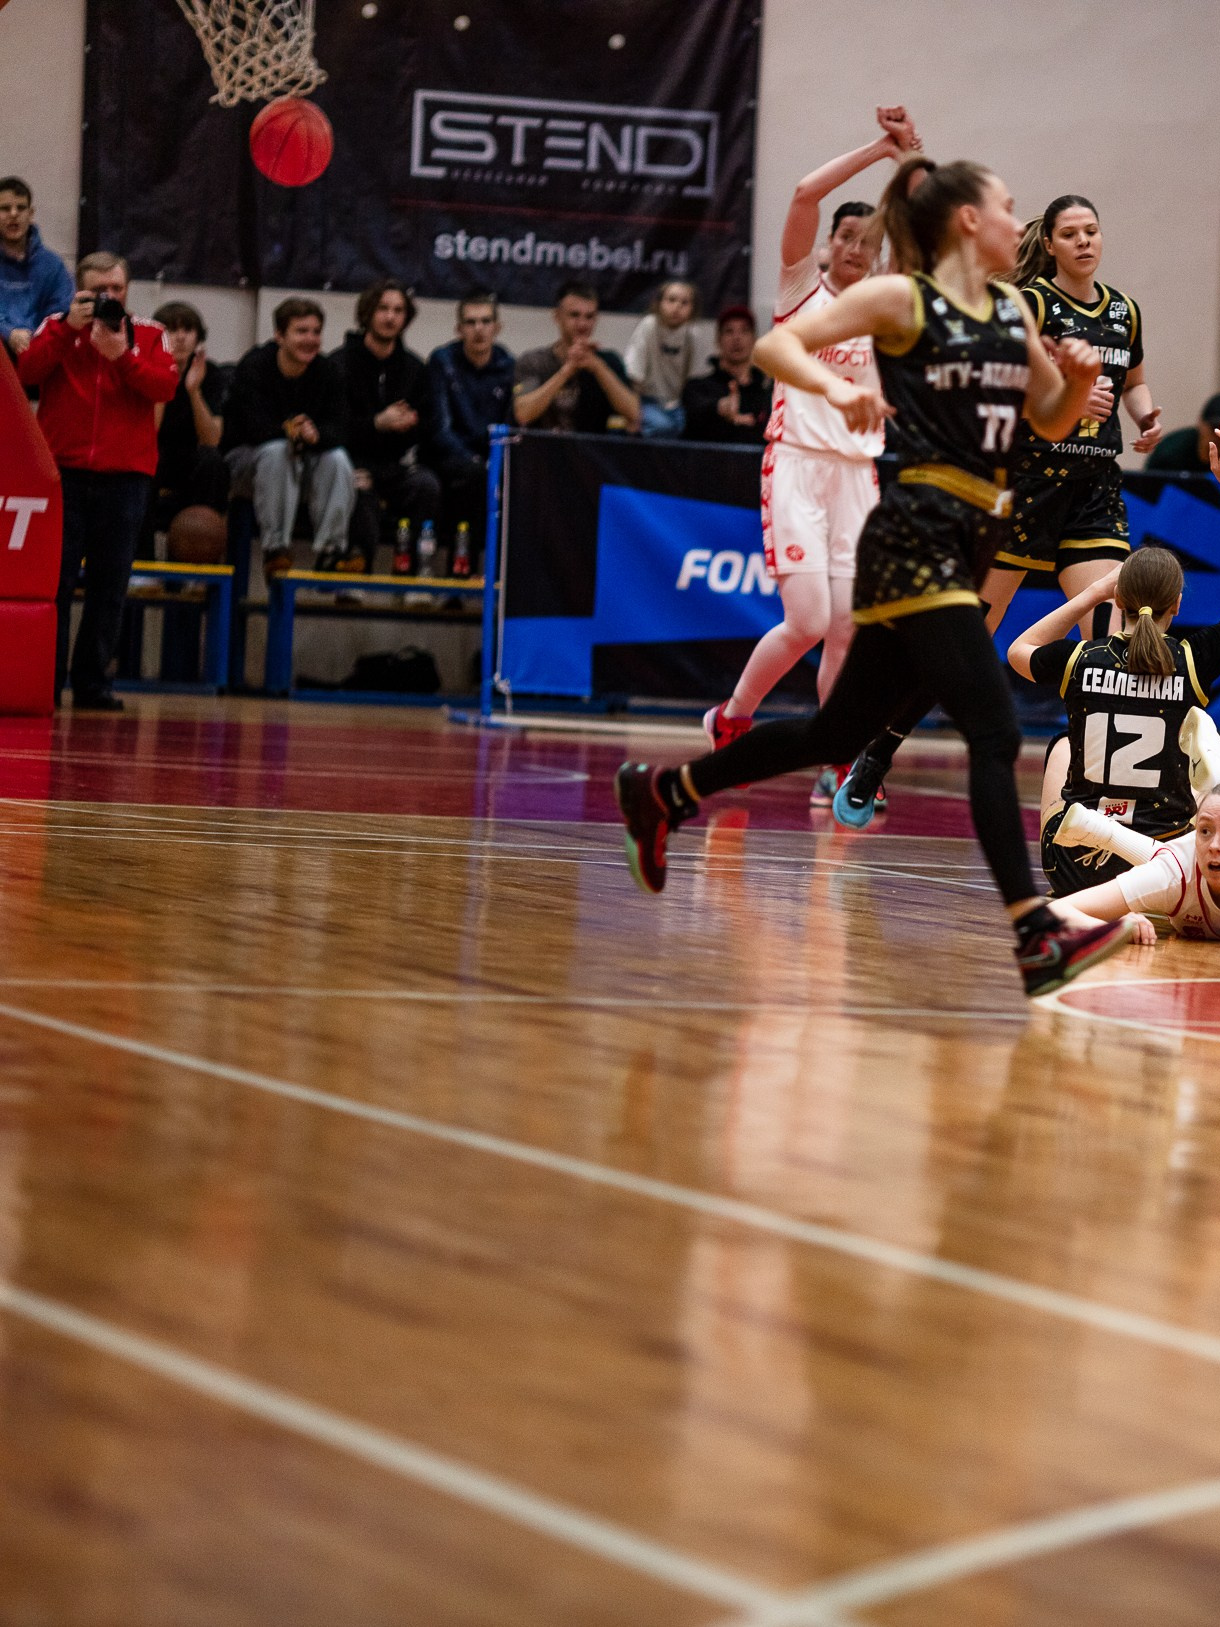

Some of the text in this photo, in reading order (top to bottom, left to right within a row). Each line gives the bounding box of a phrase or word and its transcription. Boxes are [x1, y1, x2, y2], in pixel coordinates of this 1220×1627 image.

[429, 109, 703, 179] STEND
[434, 229, 690, 274] stendmebel.ru
[1108, 310, 1128, 320] BET
[976, 403, 1017, 452] 77
[1050, 442, 1117, 458] ХИМПРОМ
[0, 496, 49, 550] T
[675, 549, 781, 596] FON
[1081, 667, 1185, 701] СЕДЛЕЦКАЯ
[1083, 711, 1167, 788] 12
